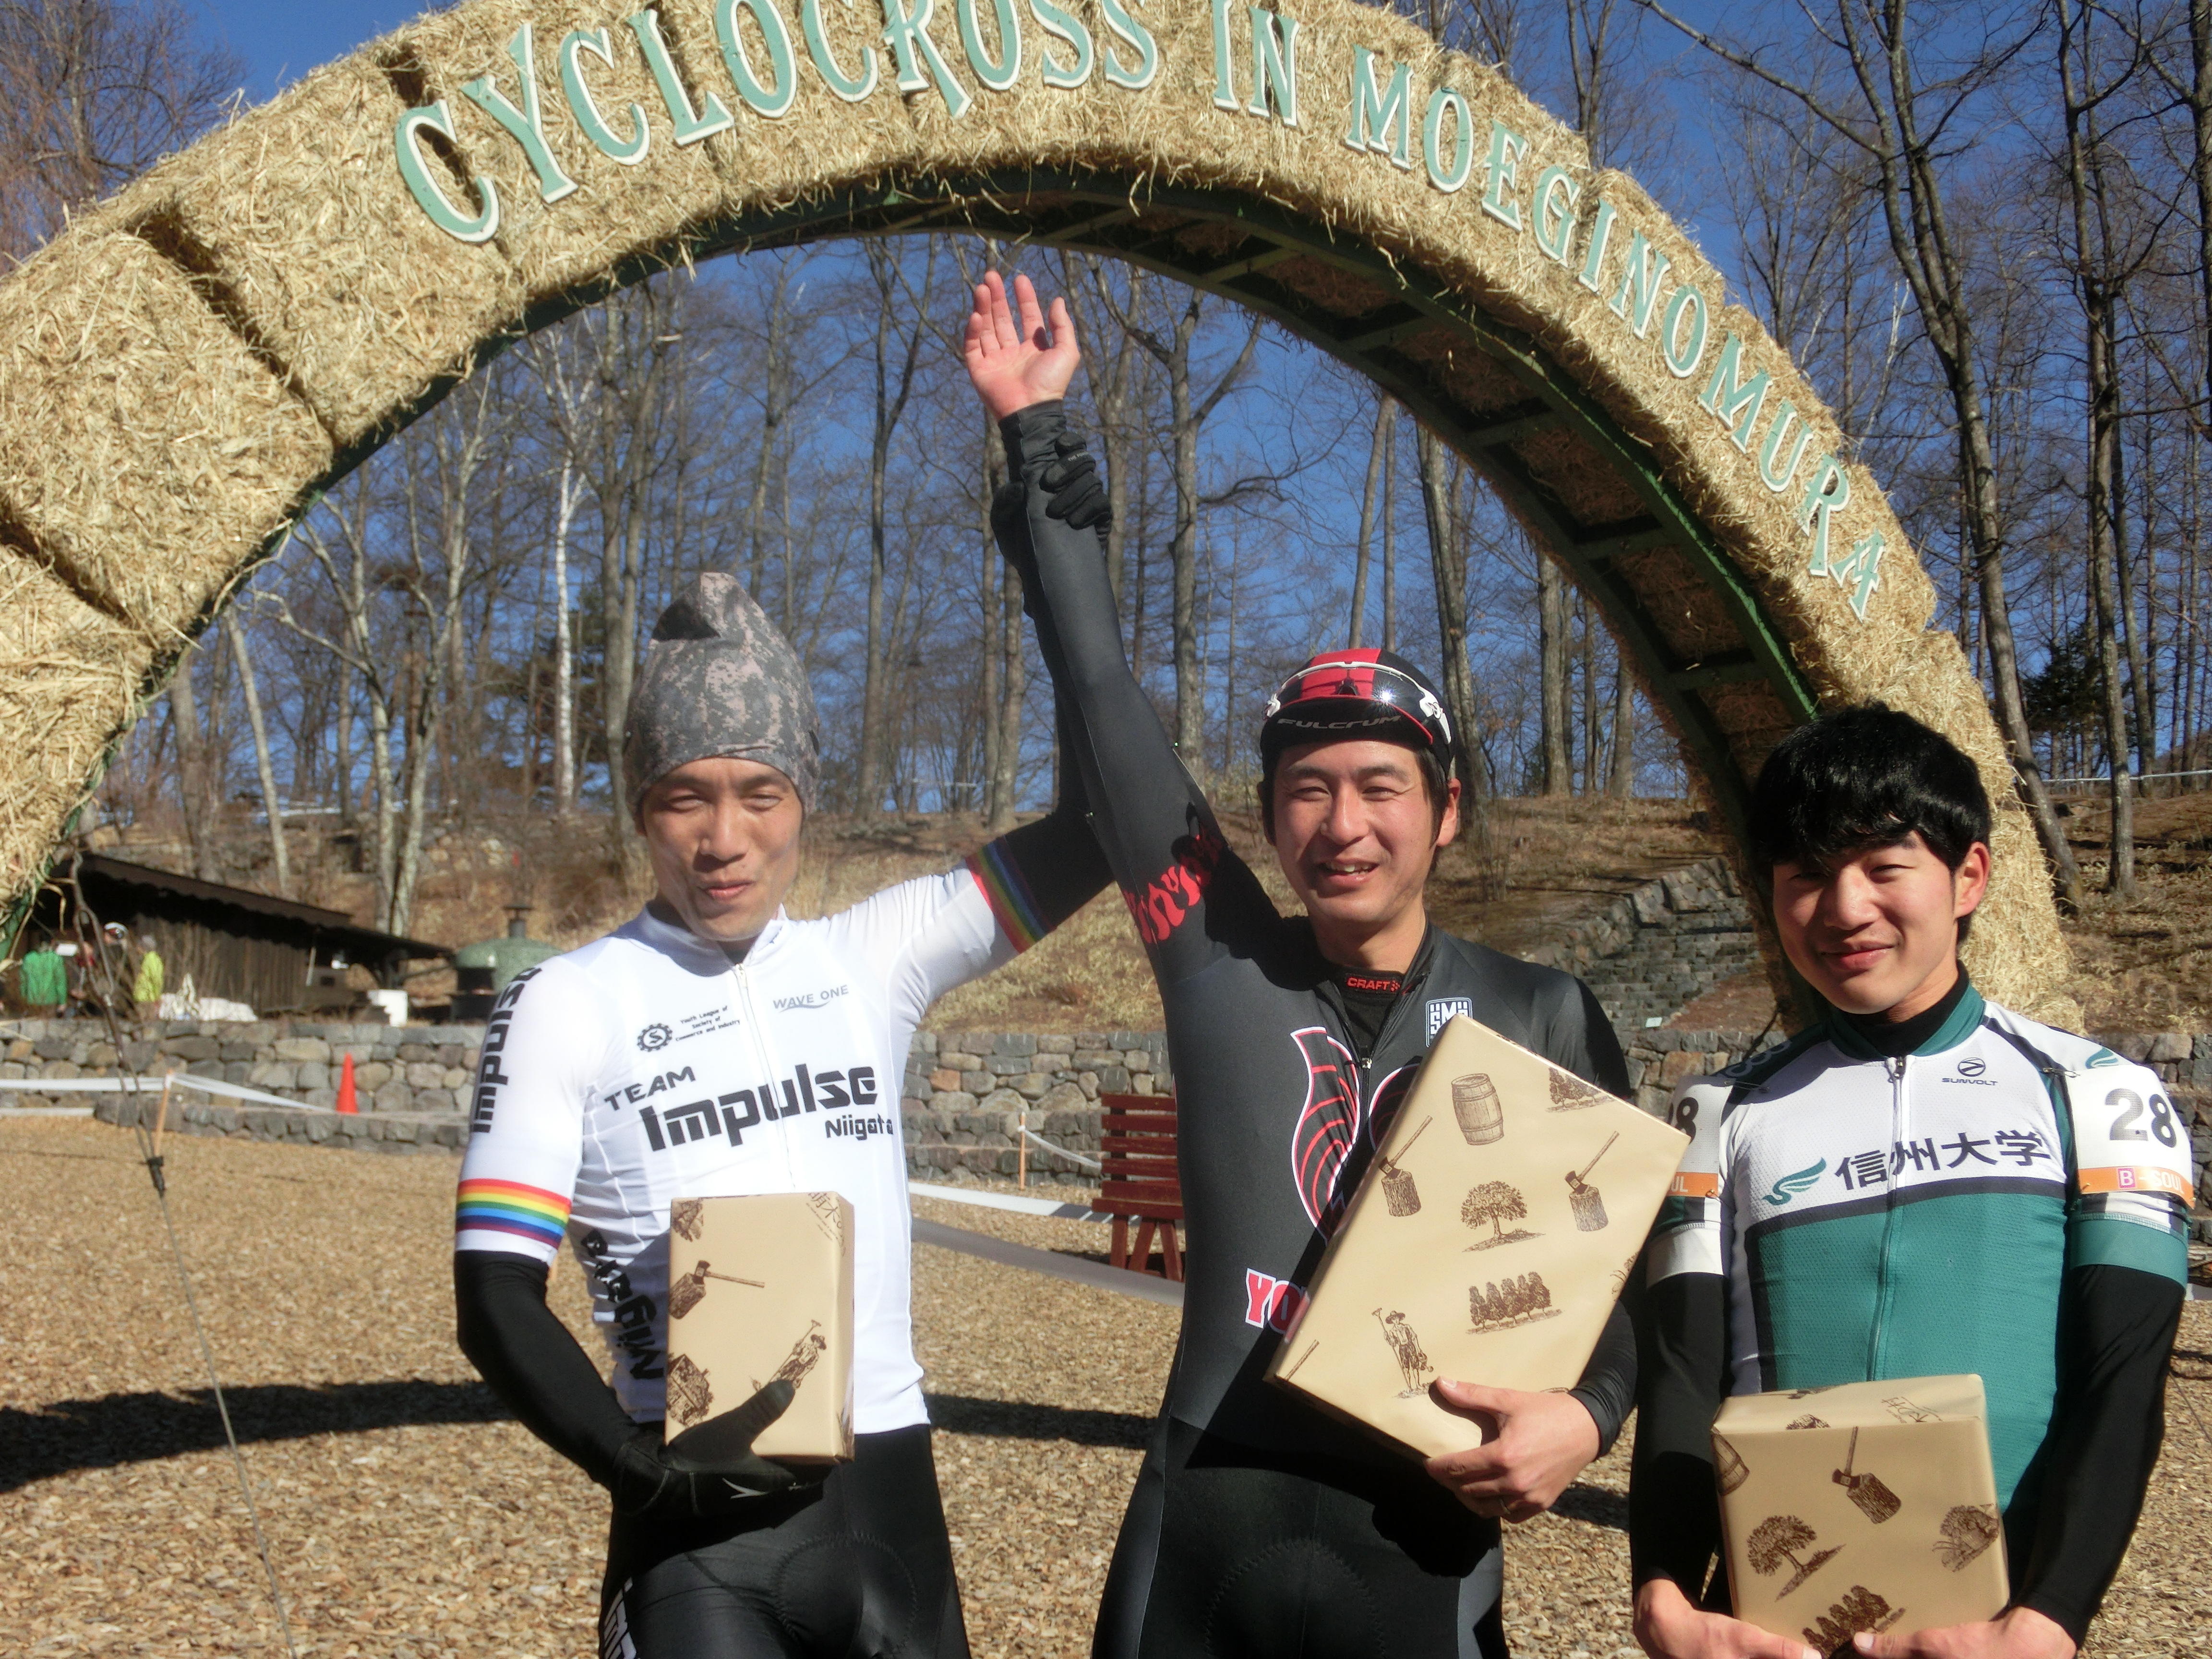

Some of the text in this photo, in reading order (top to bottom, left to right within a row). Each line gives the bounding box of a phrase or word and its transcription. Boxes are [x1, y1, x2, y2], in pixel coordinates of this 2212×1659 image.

[395, 0, 1885, 620] CYCLOCROSS IN MOEGINOMURA
[1277, 715, 1402, 729] FULCRUM
[773, 985, 849, 1009] WAVE ONE
[1347, 977, 1390, 991] CRAFT
[692, 1019, 712, 1029] Society
[699, 1009, 719, 1019] League
[604, 1066, 696, 1110] TEAM
[1942, 1078, 1998, 1086] SUNVOLT
[639, 1063, 878, 1151] Impulse
[1668, 1096, 1699, 1145] 8
[2104, 1088, 2177, 1148] 28
[825, 1113, 893, 1141] Niigata
[1834, 1130, 2051, 1190] 信州大学
